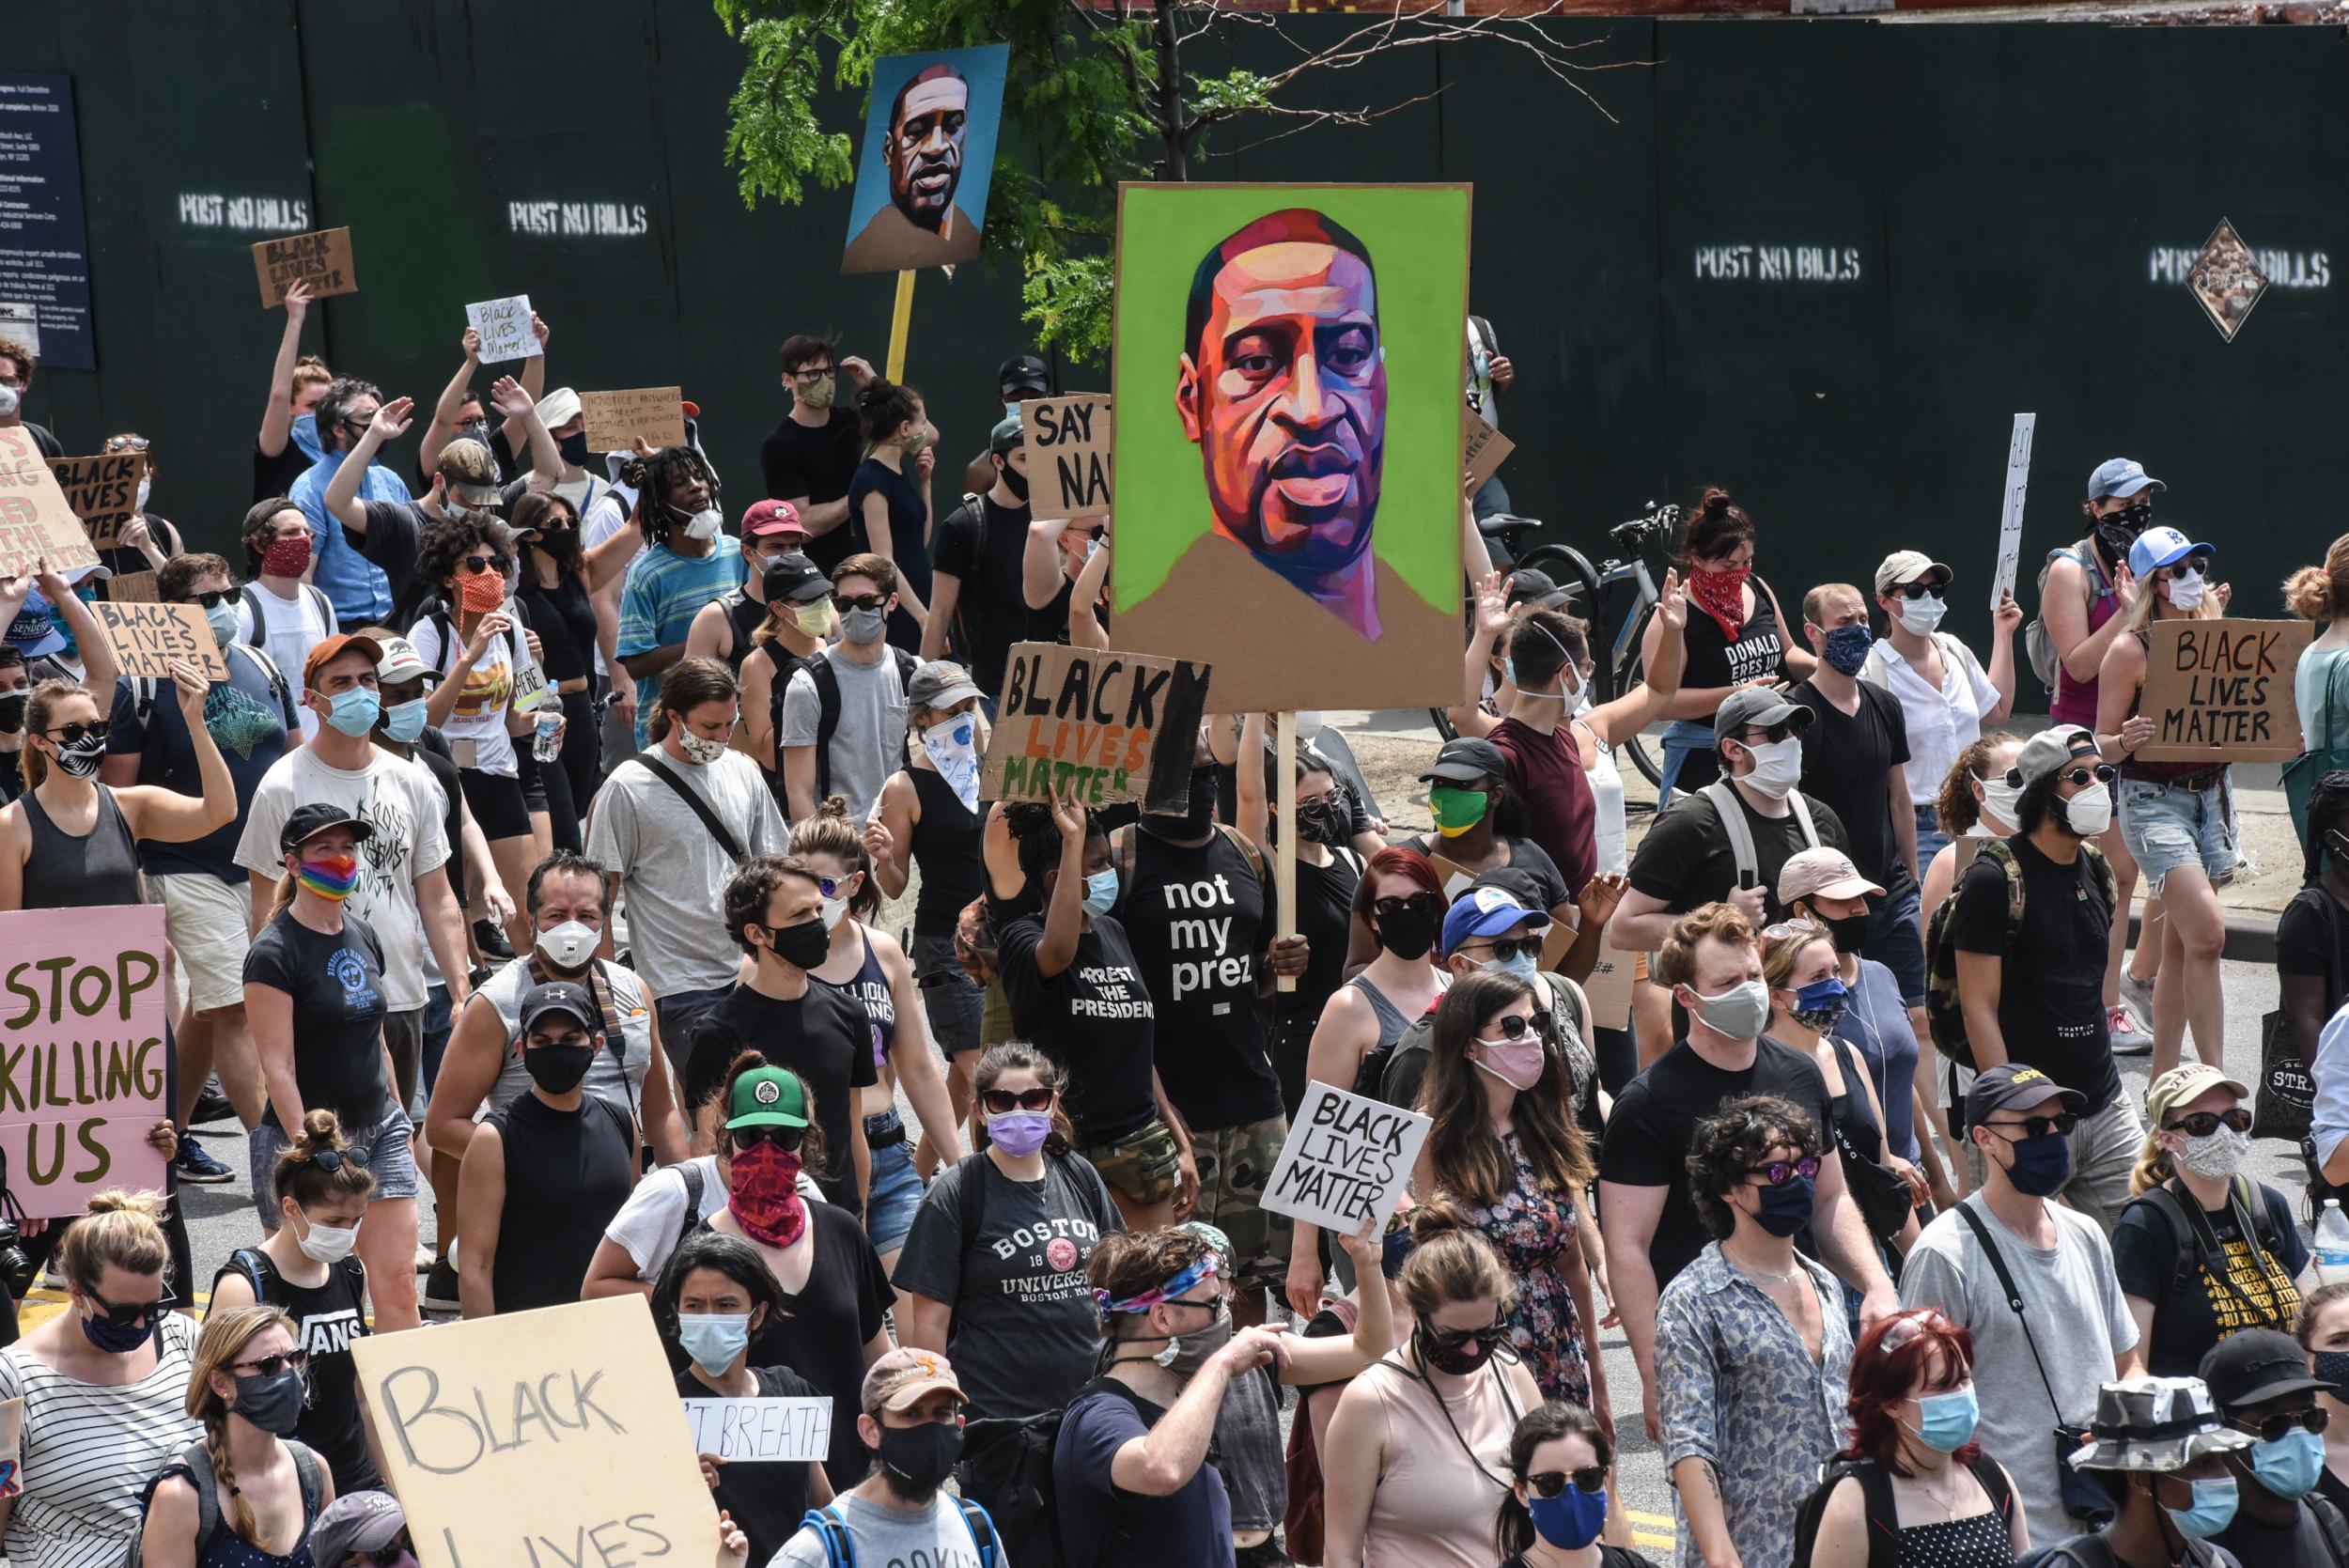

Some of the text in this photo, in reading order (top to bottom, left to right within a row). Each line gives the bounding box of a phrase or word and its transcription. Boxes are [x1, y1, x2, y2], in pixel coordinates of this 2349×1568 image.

[179, 194, 309, 230] POST NO BILLS
[508, 201, 647, 235] POST NO BILLS
[267, 234, 331, 265] BLACK
[1695, 244, 1860, 281] POST NO BILLS
[2150, 247, 2201, 284] POS
[2260, 248, 2330, 287] BILLS
[269, 256, 327, 284] LIVES
[1034, 402, 1093, 447] SAY
[54, 458, 136, 489] BLACK
[70, 482, 130, 512] IVES
[97, 603, 191, 629] BLACK
[110, 629, 197, 651] LIVES
[1724, 633, 1781, 665] DONALD
[2176, 629, 2281, 675] BLACK
[1731, 653, 1781, 680] ERES UN
[1005, 655, 1171, 731] BLACK
[2190, 675, 2270, 706] LIVES
[2162, 707, 2271, 743] MATTER
[1025, 717, 1151, 773] LIVES
[1002, 754, 1128, 804] MATTER
[1163, 874, 1235, 909] not
[1170, 916, 1232, 957] my
[4, 950, 160, 1031] STOP
[1095, 985, 1131, 1001] THE
[1172, 954, 1252, 1001] prez
[0, 1037, 163, 1113] KILLING
[2274, 1071, 2313, 1093] STR
[1313, 1092, 1413, 1156] BLACK
[26, 1117, 111, 1187] US
[1299, 1126, 1400, 1186] LIVES
[1275, 1160, 1384, 1225] MATTER
[992, 1218, 1100, 1261] BOSTON
[1030, 1254, 1043, 1267] 18
[1020, 1290, 1072, 1303] BOSTON,
[381, 1364, 628, 1475] BLACK
[721, 1405, 832, 1459] BREATH
